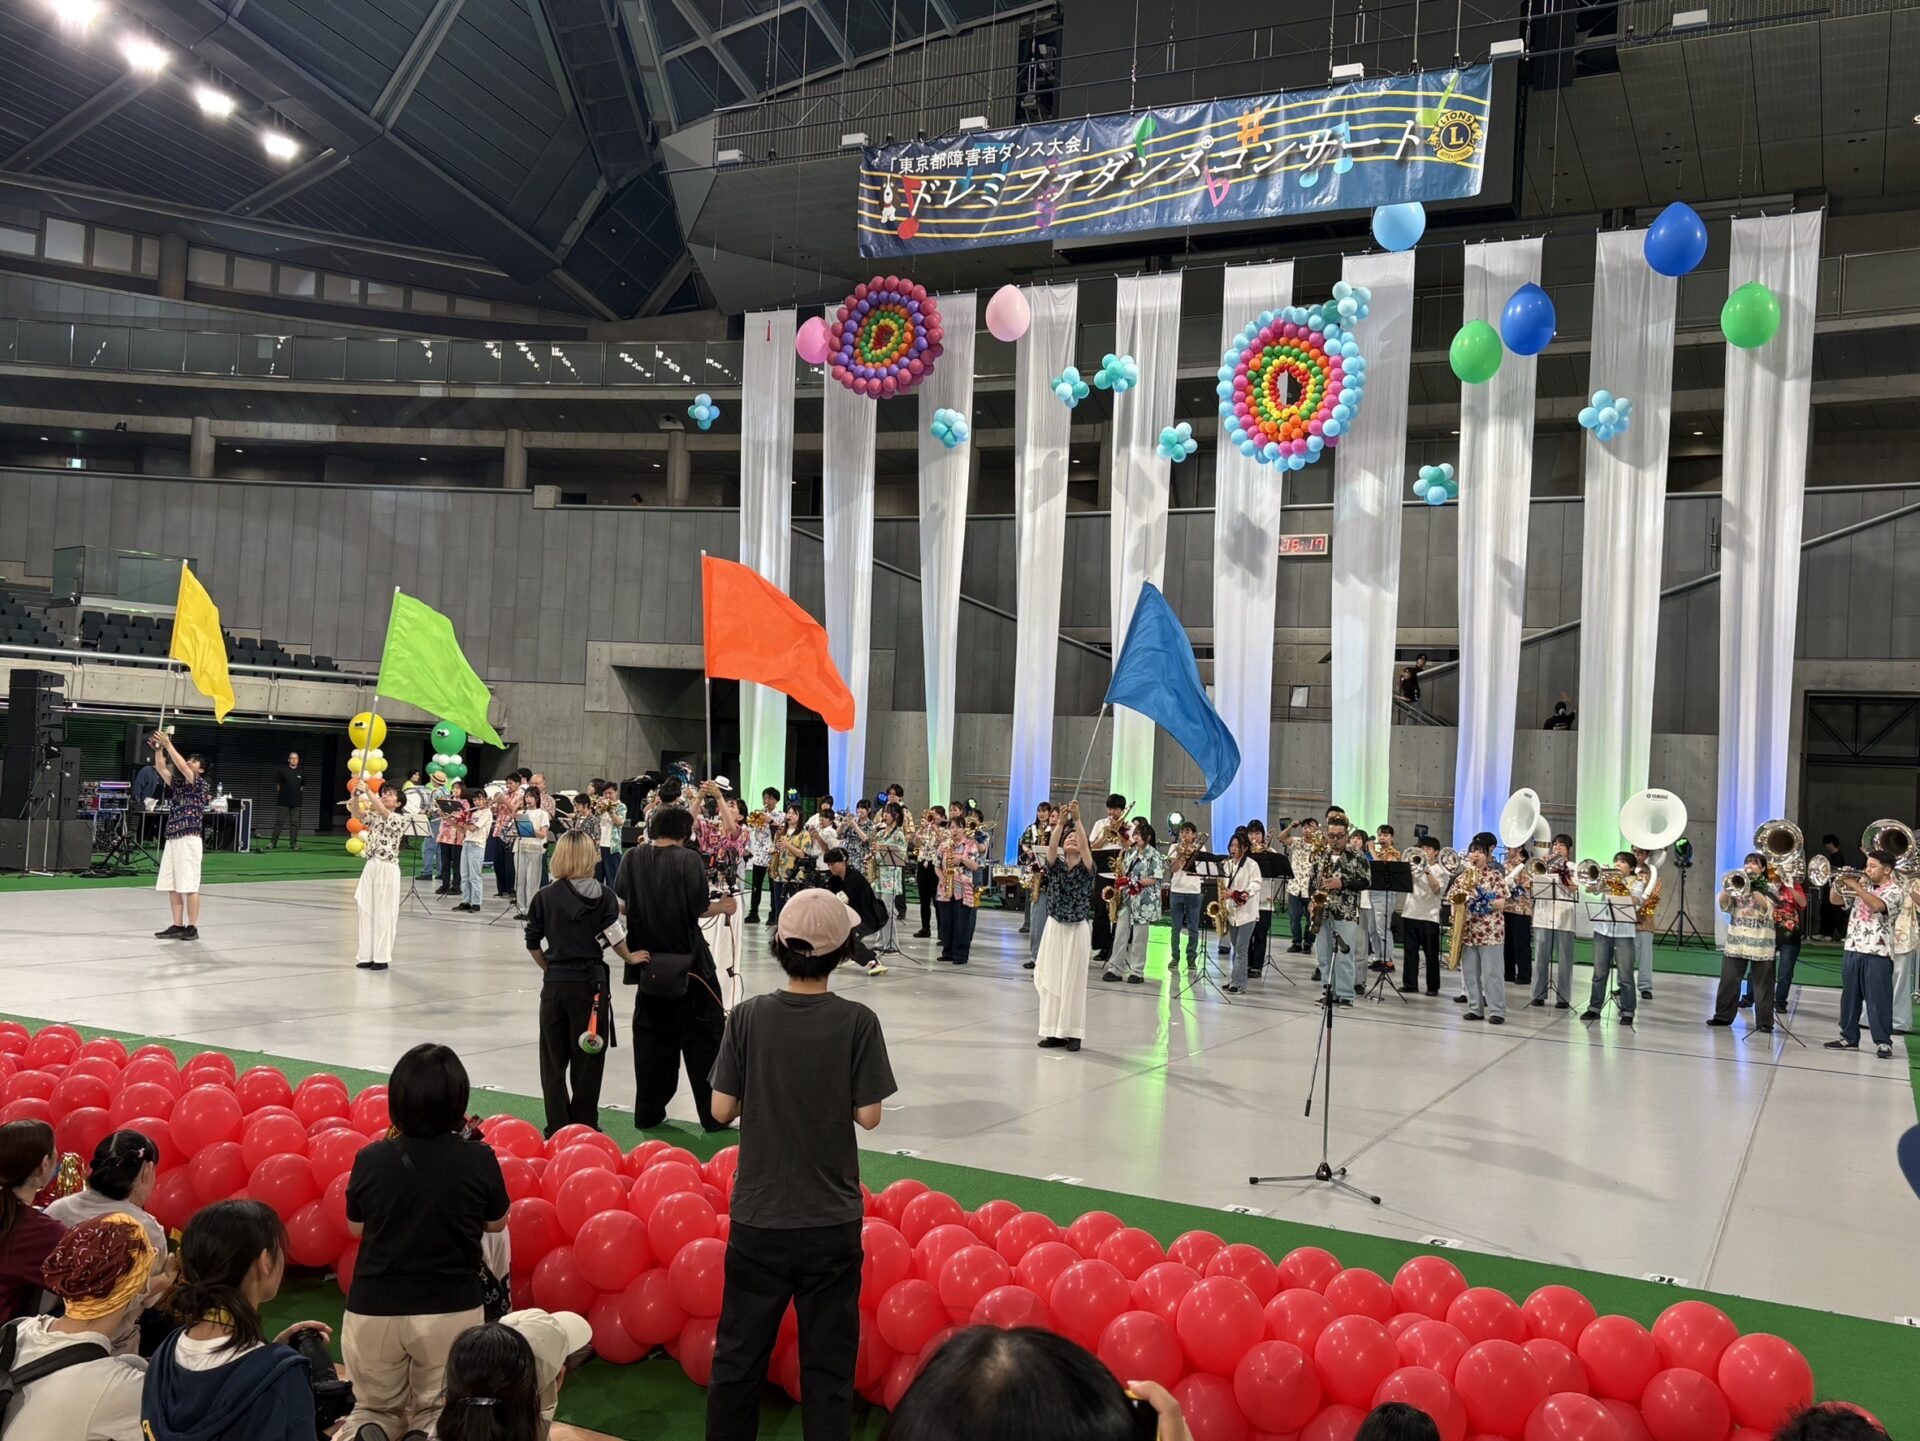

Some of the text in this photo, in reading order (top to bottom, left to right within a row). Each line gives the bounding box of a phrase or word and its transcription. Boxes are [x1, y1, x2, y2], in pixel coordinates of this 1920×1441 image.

[1440, 112, 1473, 125] LIONS
[1448, 126, 1464, 145] L
[889, 135, 1091, 176] 「東京都障害者ダンス大会」
